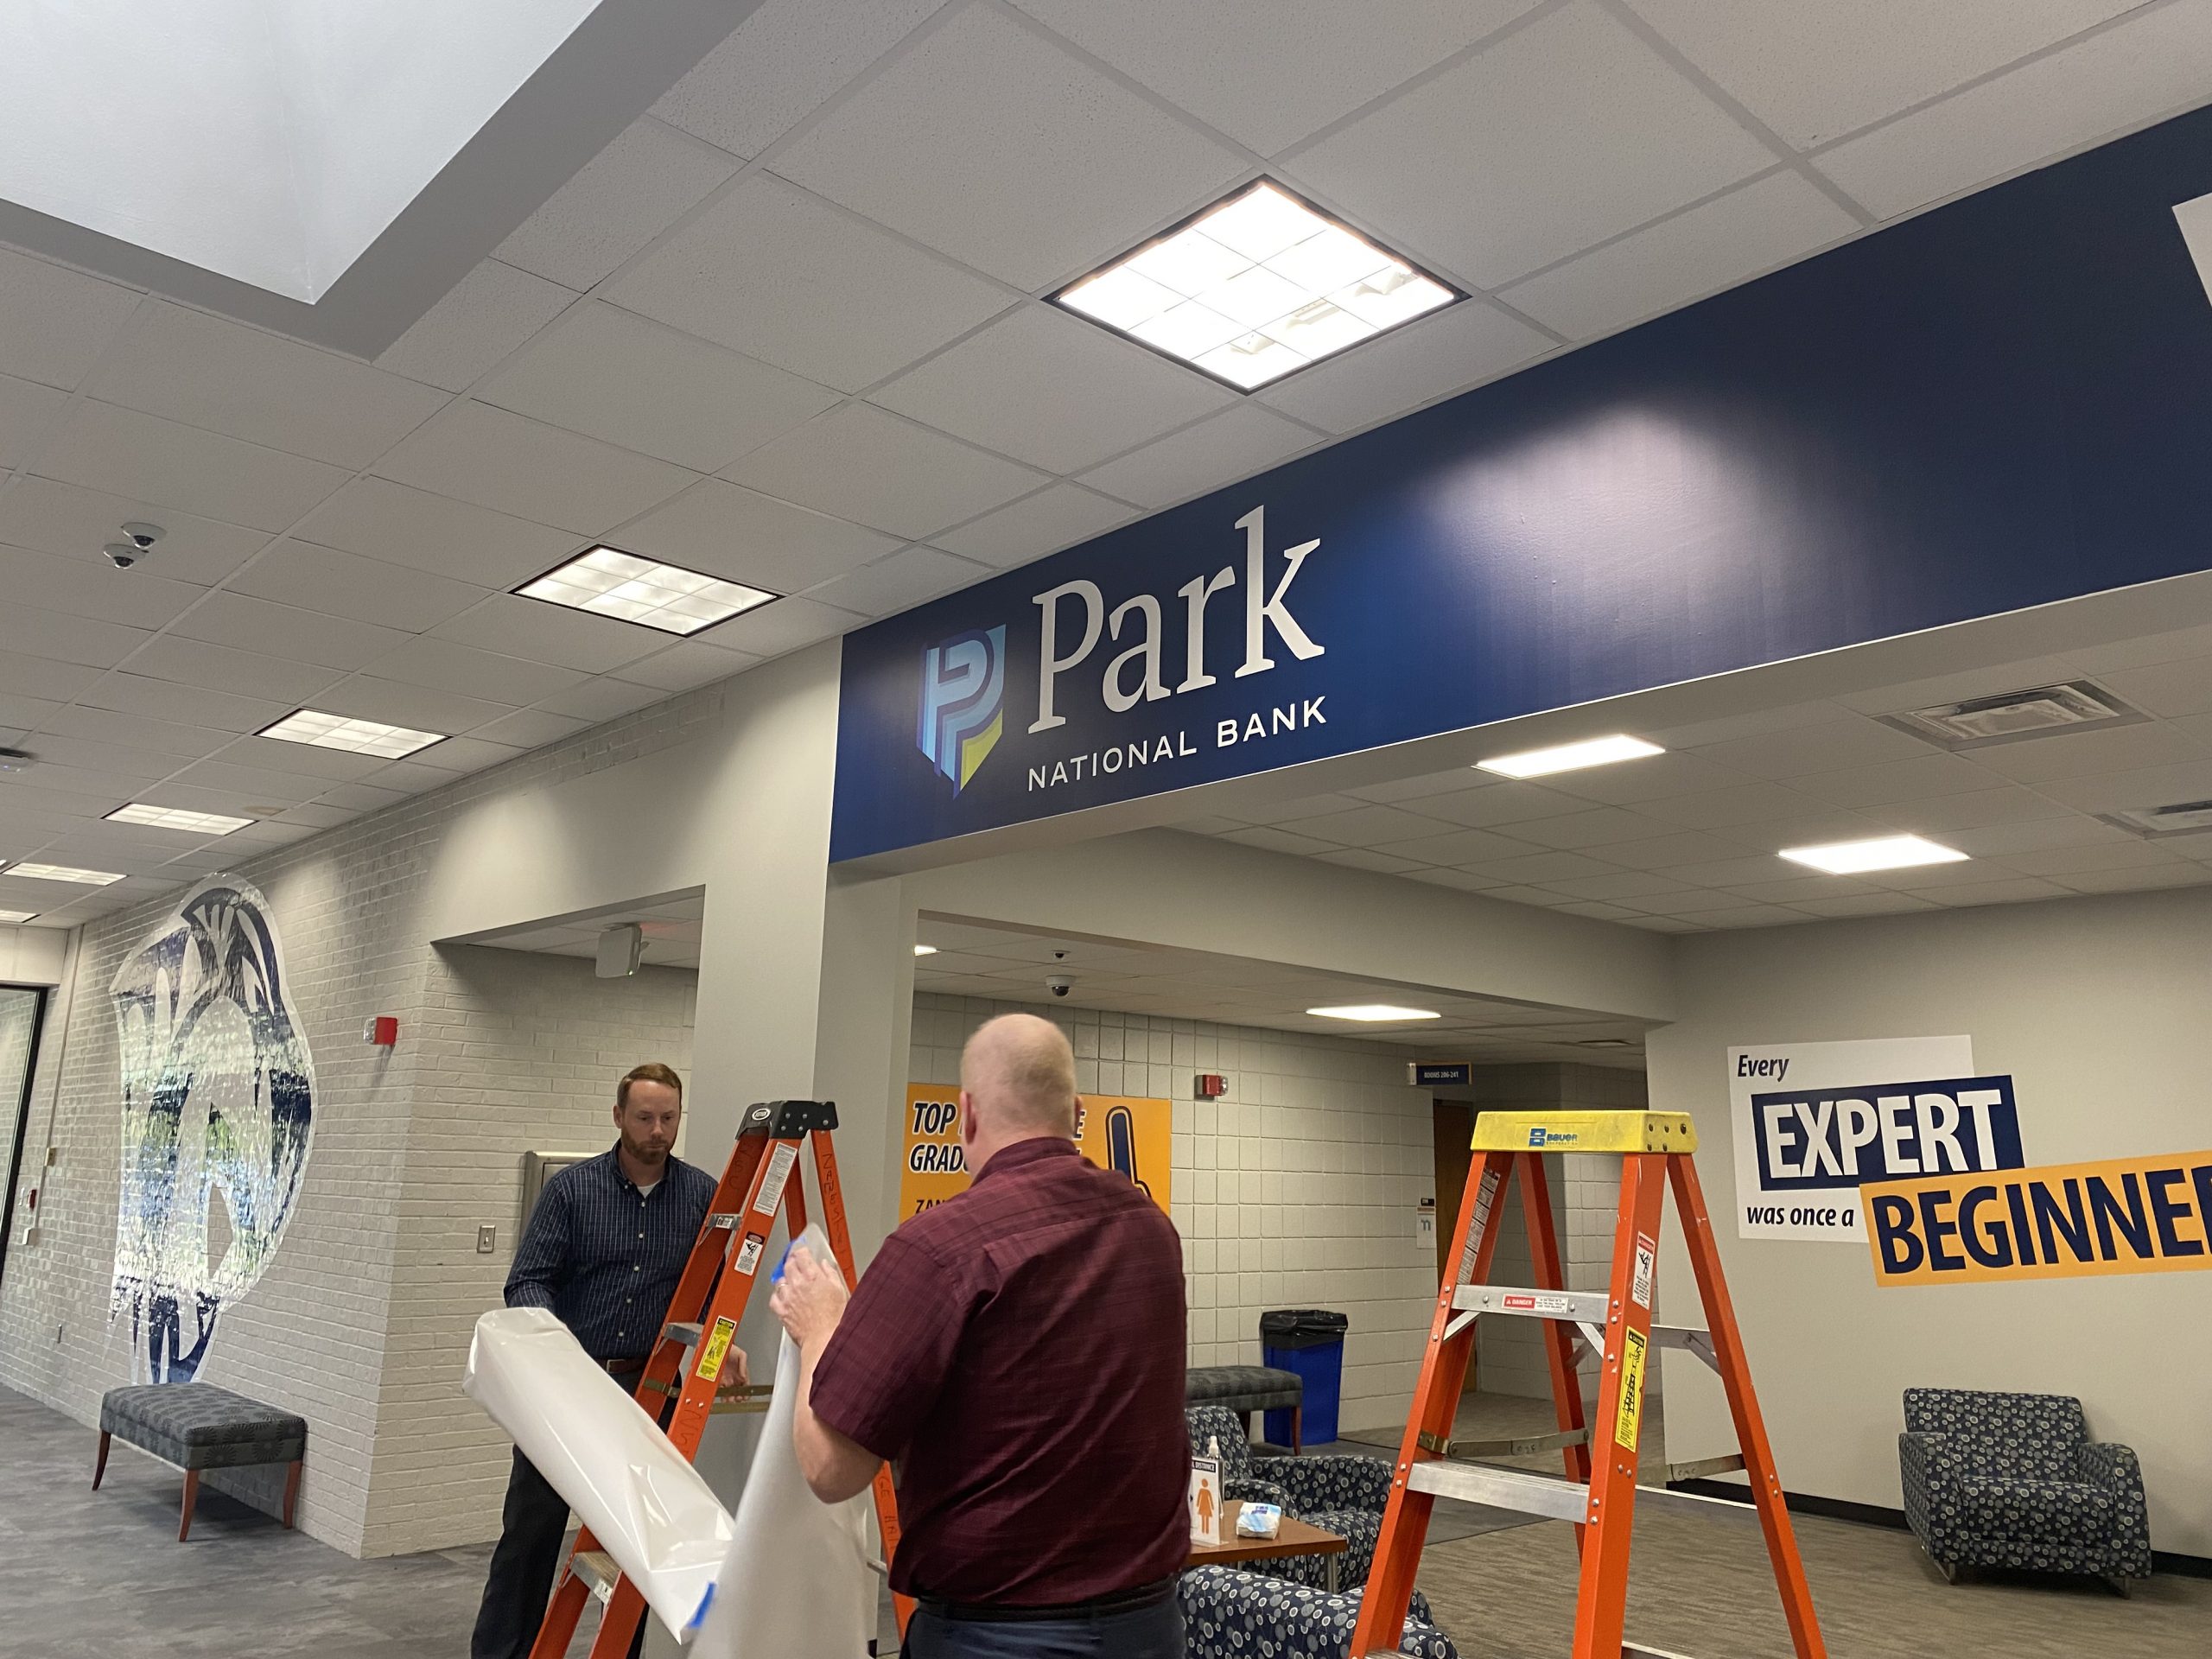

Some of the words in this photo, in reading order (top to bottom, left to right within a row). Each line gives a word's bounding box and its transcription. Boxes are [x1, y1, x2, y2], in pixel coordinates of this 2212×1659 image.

[1027, 504, 1325, 734] Park
[1027, 730, 1198, 792] NATIONAL
[1217, 696, 1327, 748] BANK
[1737, 1054, 1790, 1083] Every
[912, 1101, 958, 1136] TOP
[1763, 1089, 2002, 1179] EXPERT
[1746, 1206, 1785, 1224] was
[1790, 1206, 1836, 1226] once
[1841, 1208, 1854, 1227] a
